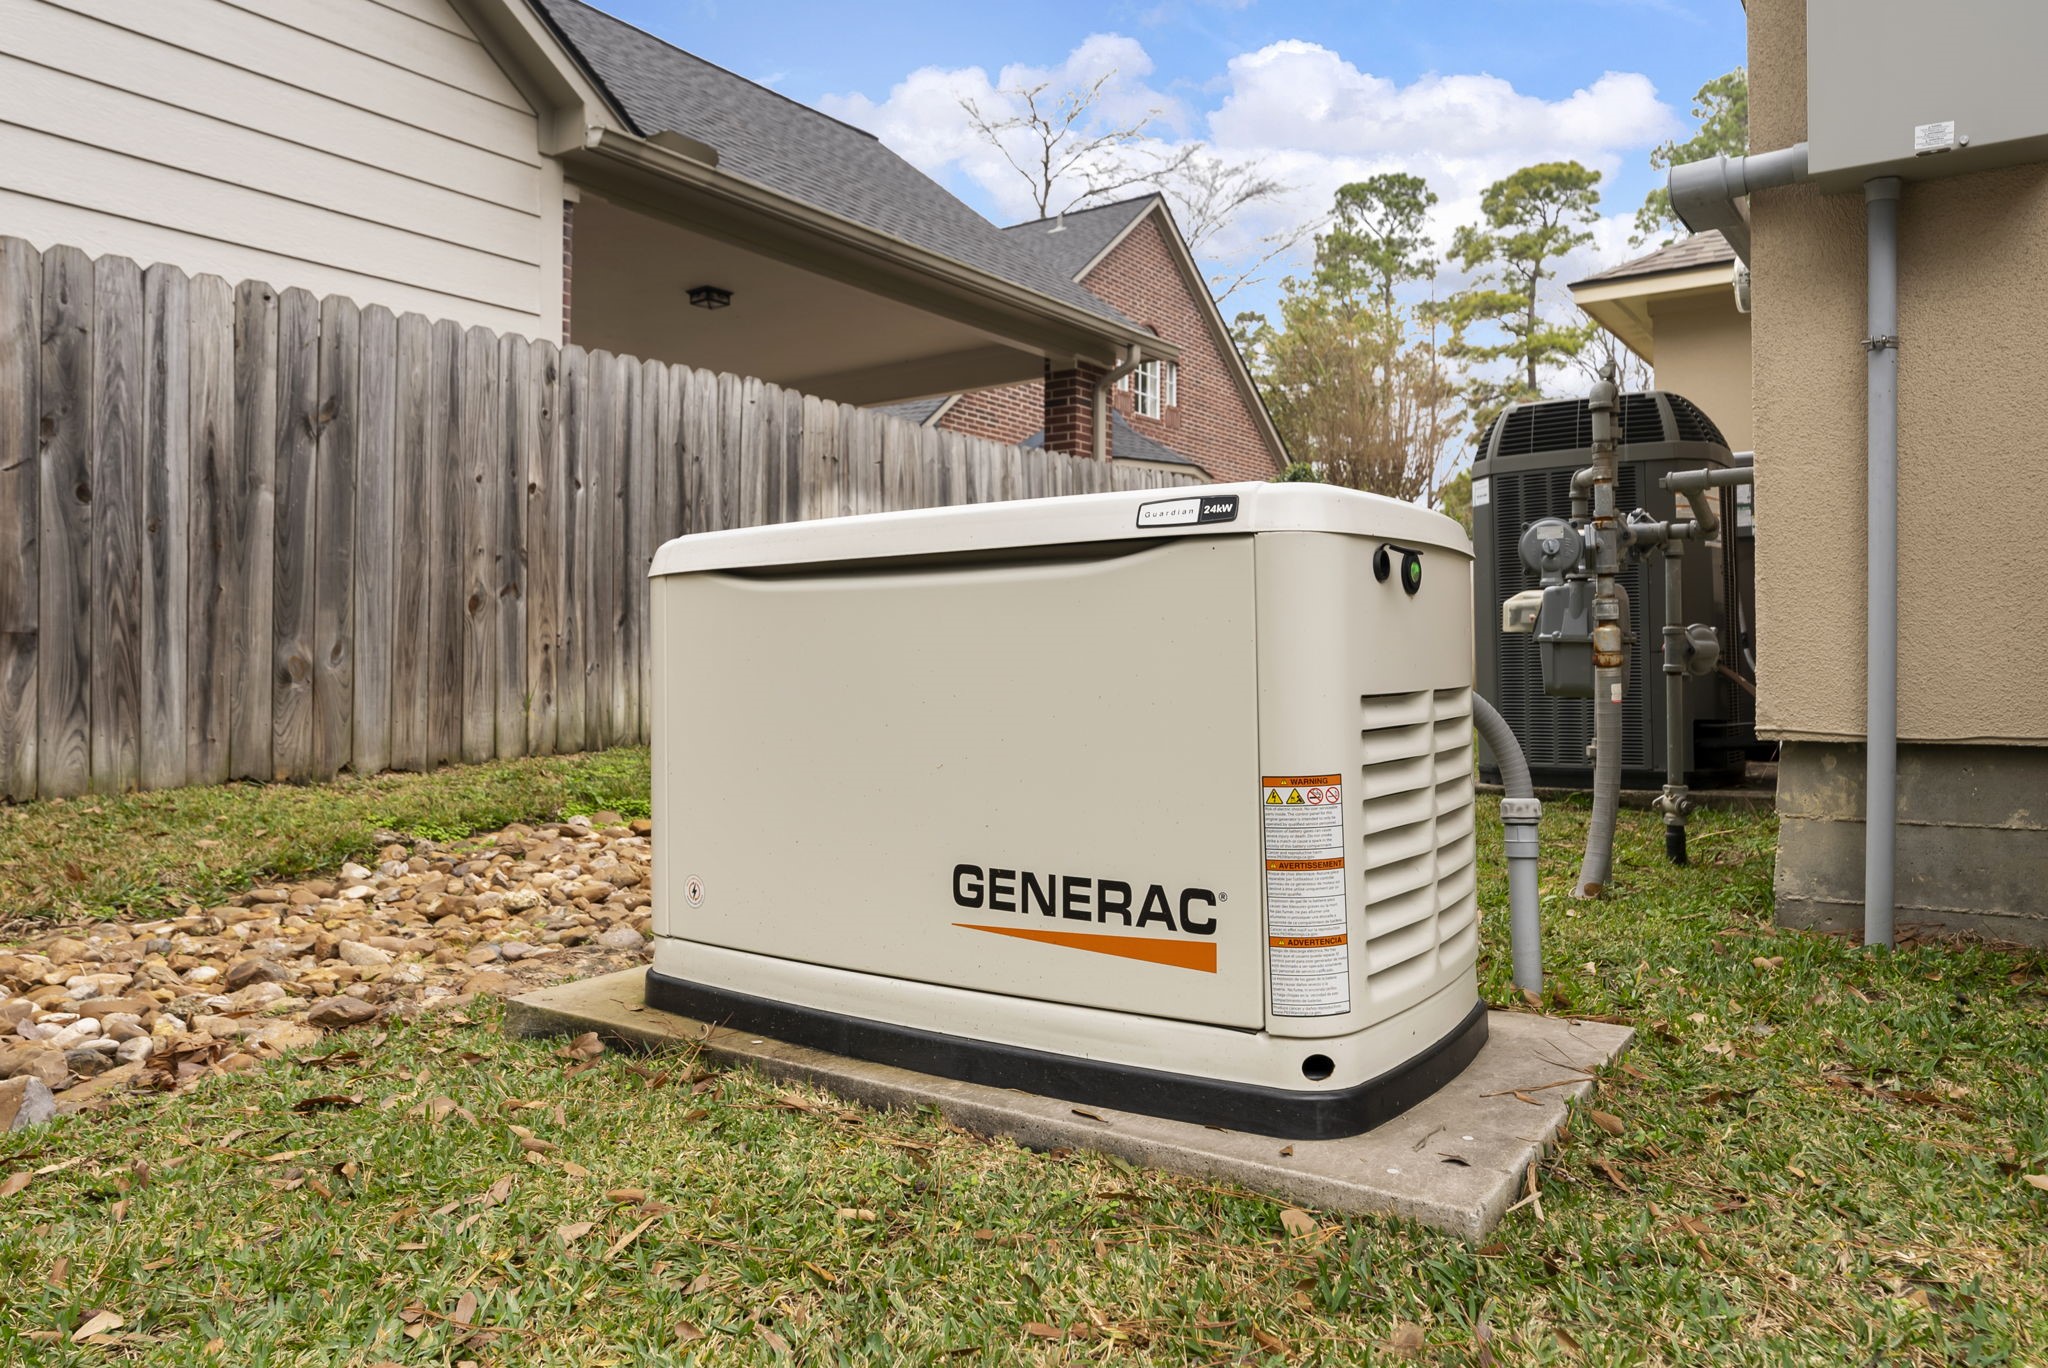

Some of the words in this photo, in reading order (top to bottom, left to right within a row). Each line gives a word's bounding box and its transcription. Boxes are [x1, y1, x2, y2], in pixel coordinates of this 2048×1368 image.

[1144, 508, 1194, 518] Guardian
[1203, 503, 1233, 514] 24kW
[1290, 777, 1329, 785] WARNING
[1279, 860, 1342, 869] AVERTISSEMENT
[952, 863, 1217, 935] GENERAC
[1288, 937, 1342, 946] ADVERTENCIA
